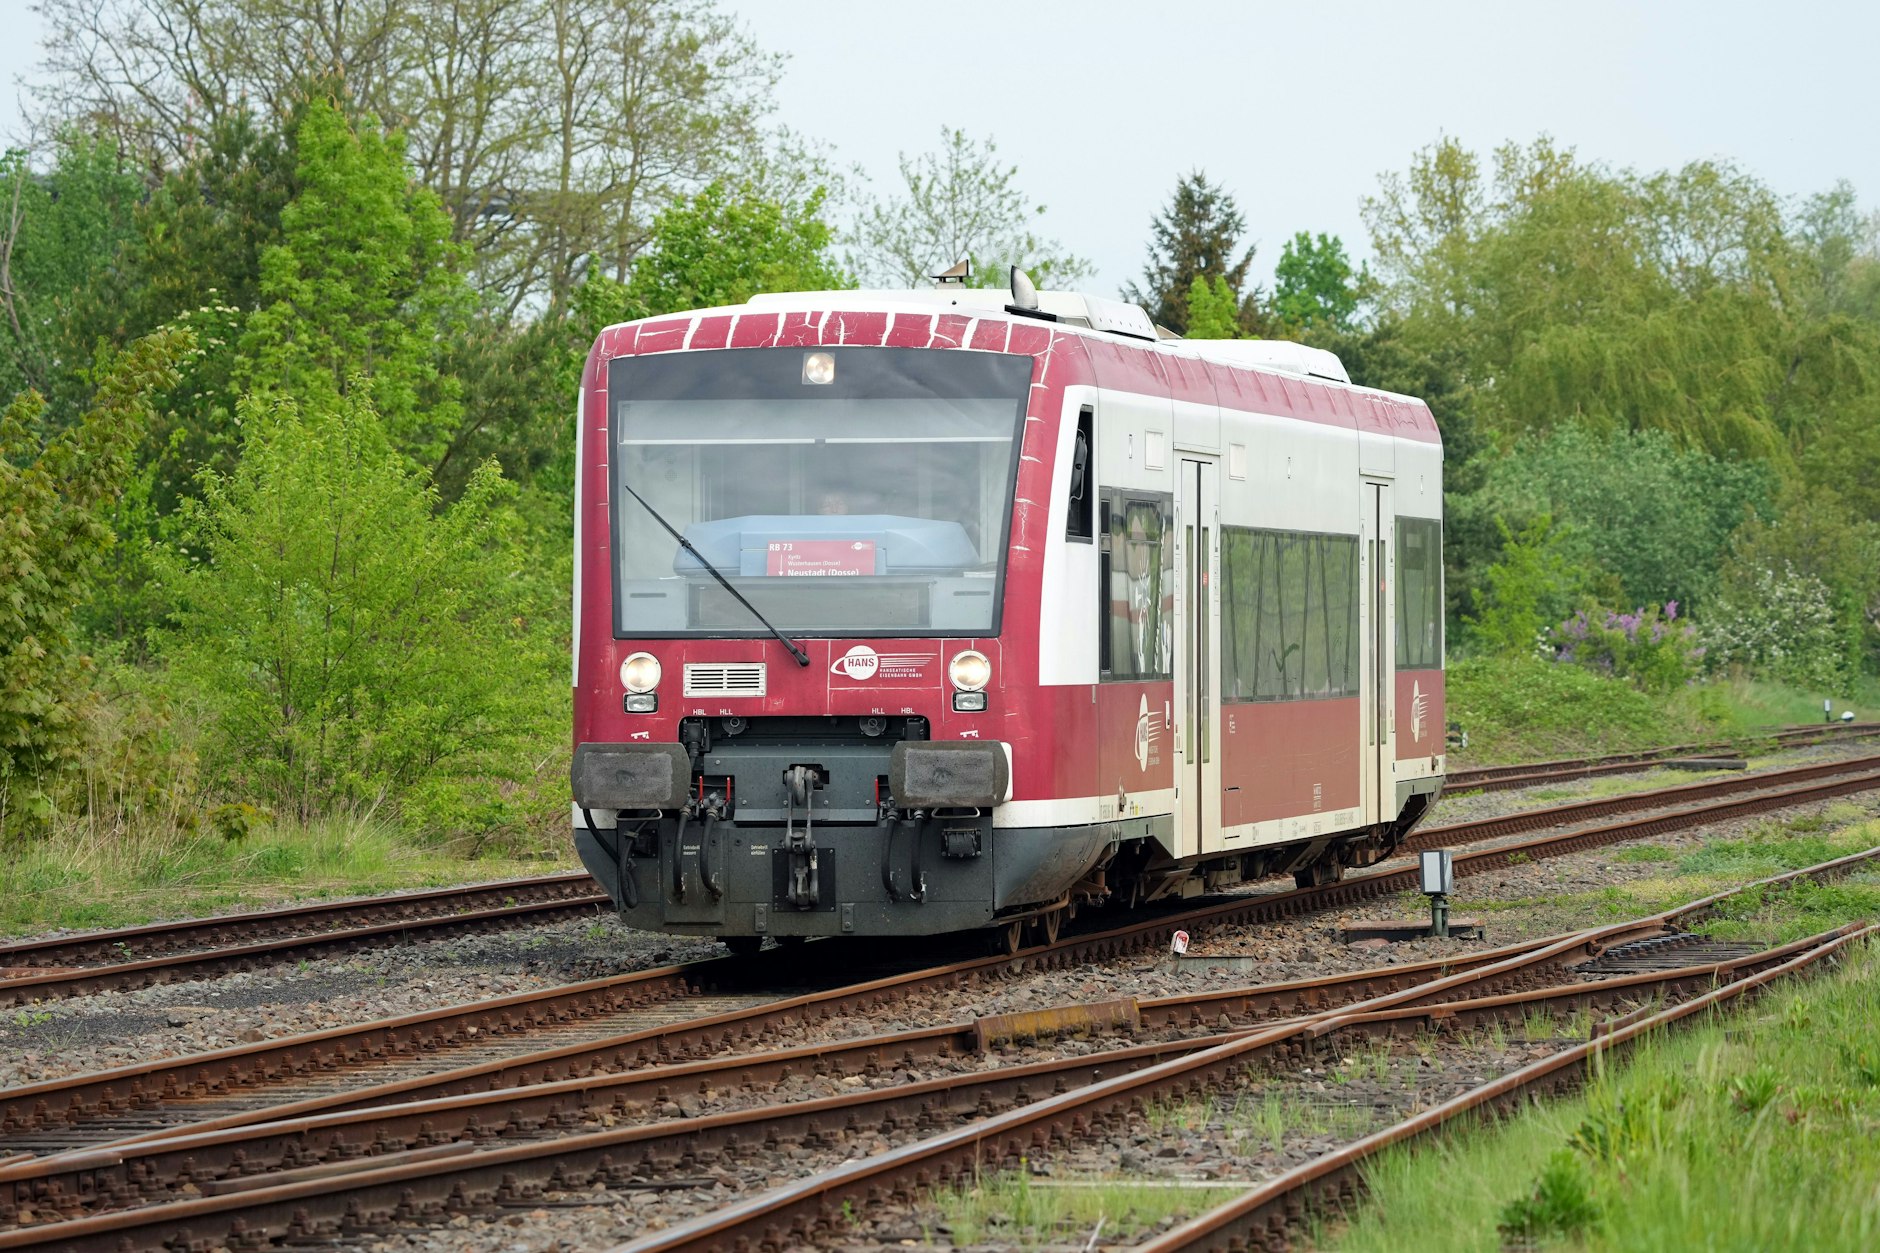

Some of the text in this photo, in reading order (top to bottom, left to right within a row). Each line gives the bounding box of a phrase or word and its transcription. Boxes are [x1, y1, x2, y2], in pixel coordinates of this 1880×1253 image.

[769, 543, 793, 552] RB 73
[787, 568, 859, 576] Neustadt (Dosse)
[848, 658, 875, 667] HANS
[693, 708, 707, 716] HBL
[720, 708, 733, 716] HLL
